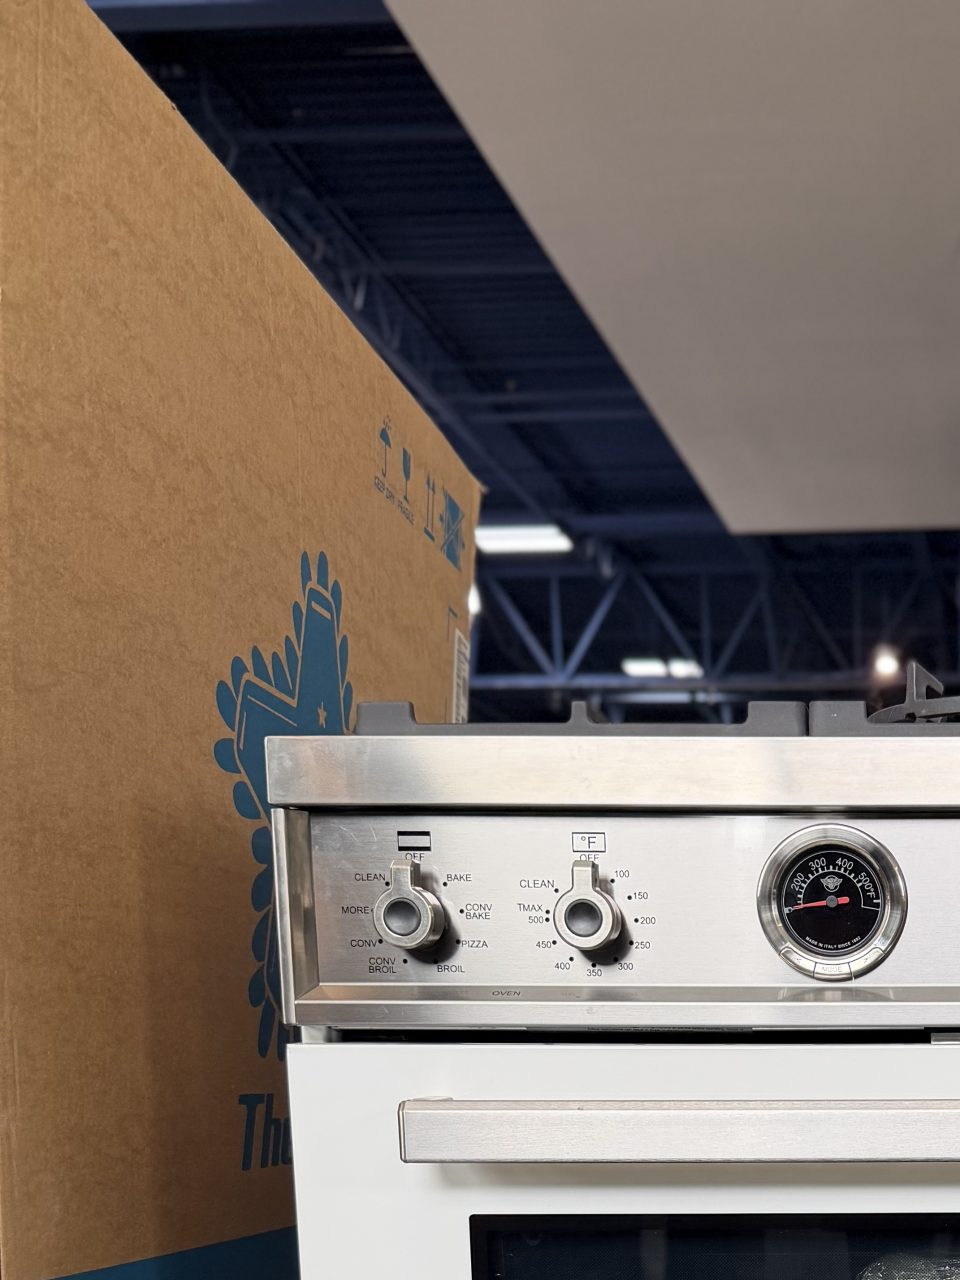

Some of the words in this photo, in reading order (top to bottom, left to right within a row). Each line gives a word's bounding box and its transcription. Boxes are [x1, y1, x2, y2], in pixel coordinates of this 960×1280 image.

[580, 834, 597, 849] °F
[405, 853, 425, 861] OFF
[580, 854, 599, 862] OFF
[354, 873, 386, 882] CLEAN
[446, 873, 472, 882] BAKE
[614, 870, 630, 879] 100
[791, 872, 805, 891] 200
[809, 857, 827, 870] 300
[836, 857, 854, 870] 400
[858, 872, 876, 898] 500°F
[519, 879, 555, 889] CLEAN
[633, 892, 649, 900] 150
[341, 906, 370, 914] MORE
[465, 903, 493, 912] CONV
[517, 903, 543, 913] TMAX
[465, 912, 491, 920] BAKE
[528, 916, 544, 924] 500
[640, 916, 656, 925] 200
[350, 939, 377, 948] CONV
[461, 940, 489, 949] PIZZA
[535, 940, 552, 949] 450
[634, 941, 651, 950] 250
[368, 957, 396, 966] CONV
[368, 966, 397, 974] BROIL
[437, 965, 465, 973] BROIL
[554, 962, 571, 971] 400
[617, 962, 634, 971] 300
[586, 969, 602, 977] 350
